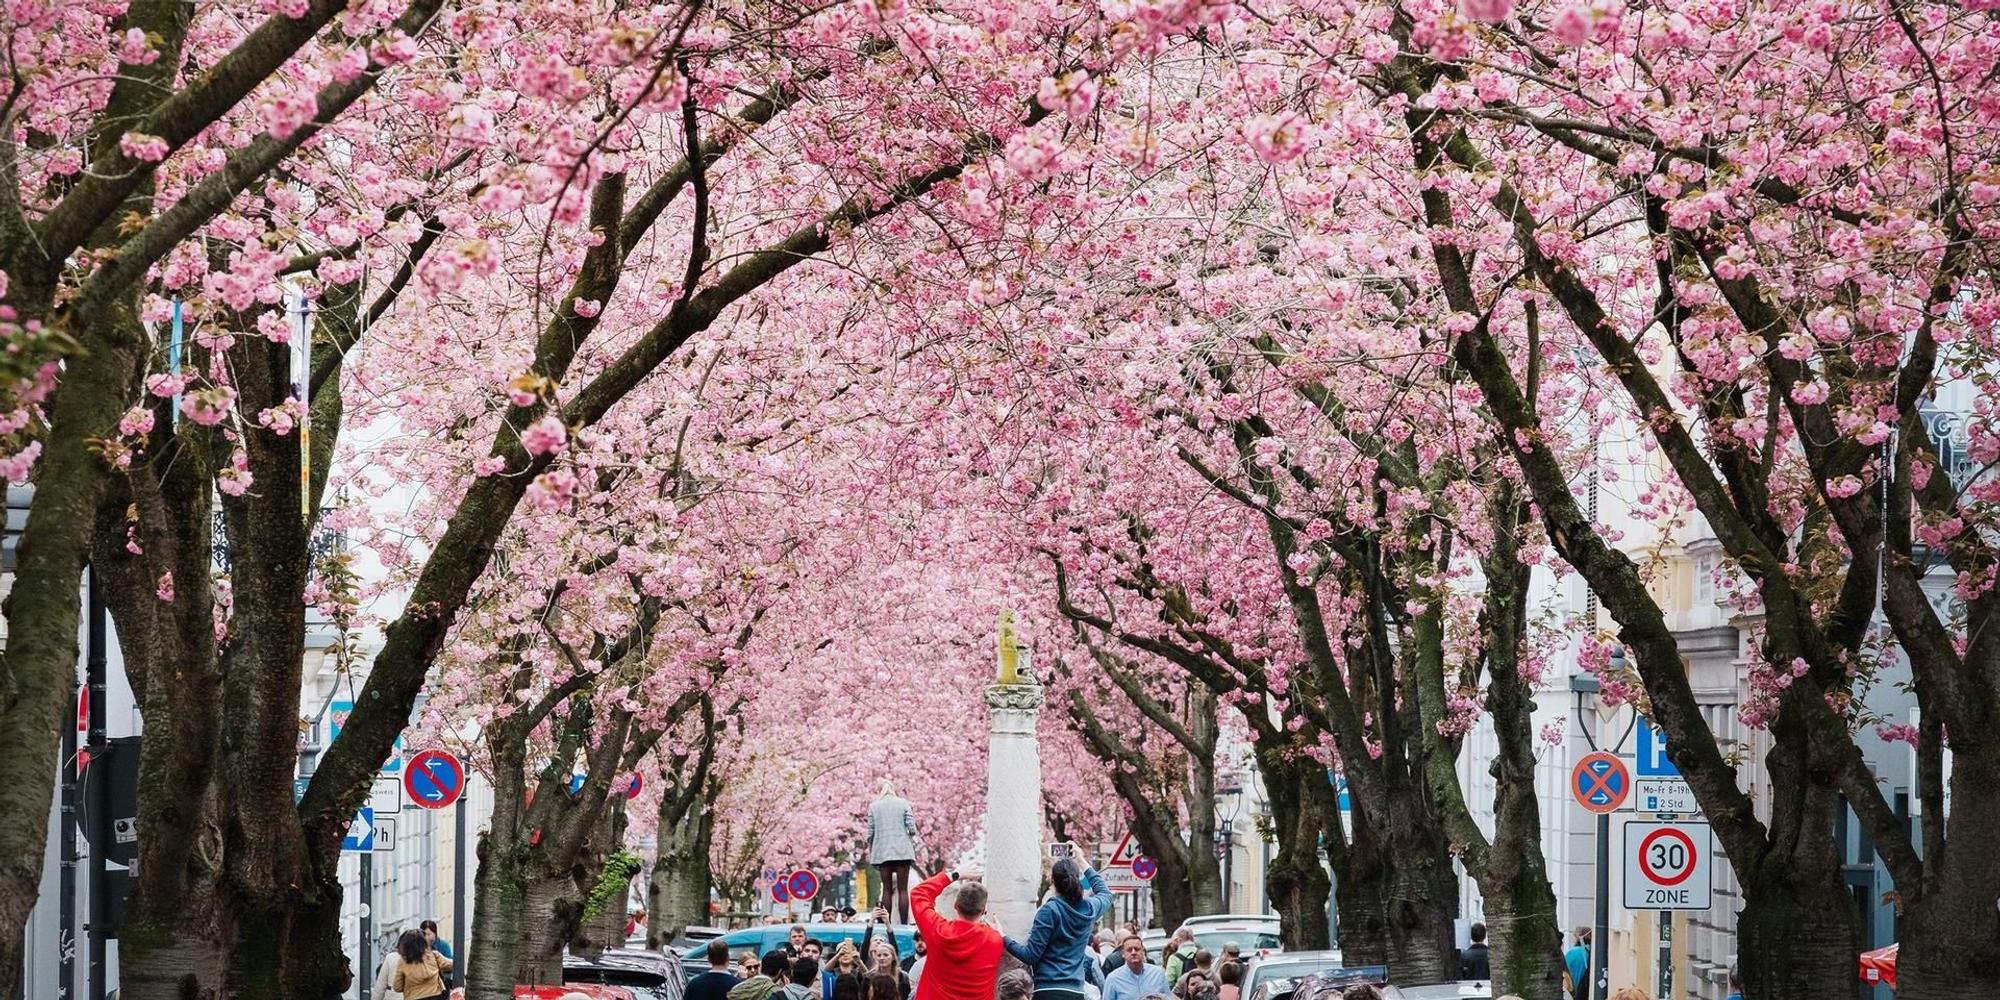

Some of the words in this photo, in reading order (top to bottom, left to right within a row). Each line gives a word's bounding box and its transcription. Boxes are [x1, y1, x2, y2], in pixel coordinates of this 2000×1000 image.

[1643, 786, 1665, 794] Mo-Fr
[1660, 799, 1666, 808] 2
[1651, 844, 1685, 870] 30
[1105, 873, 1133, 881] Zufahrt
[1646, 890, 1689, 904] ZONE
